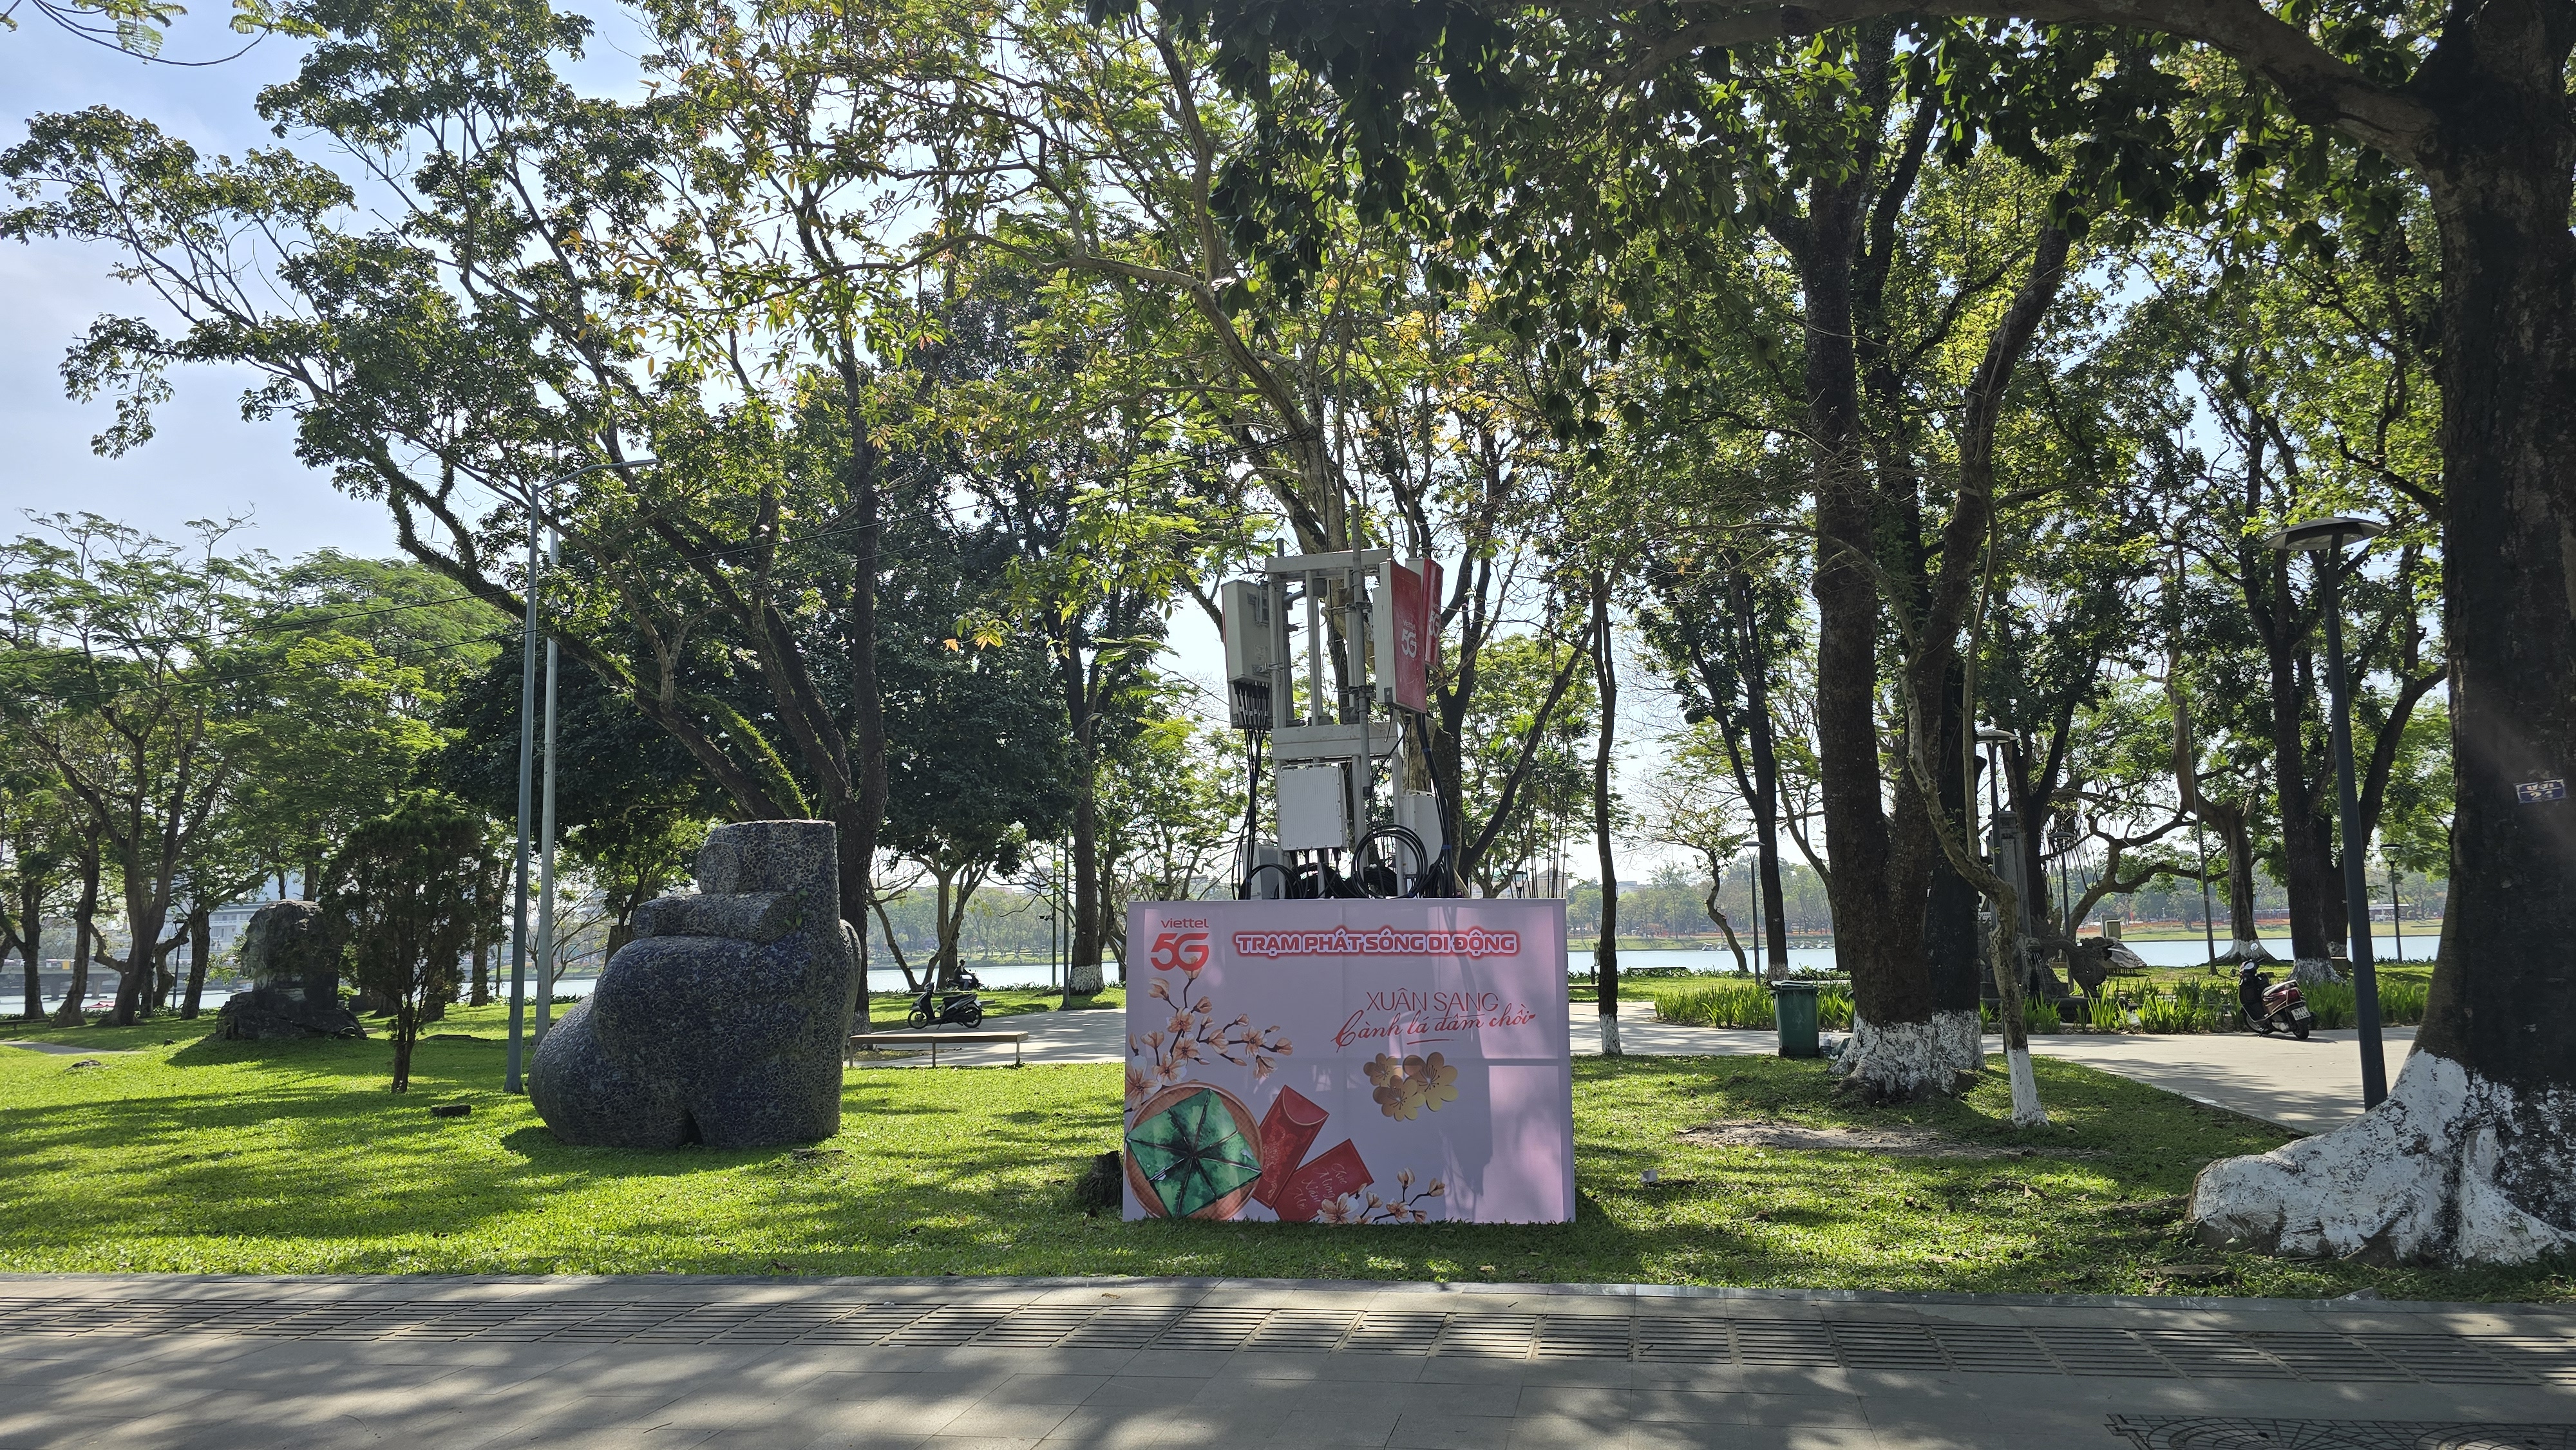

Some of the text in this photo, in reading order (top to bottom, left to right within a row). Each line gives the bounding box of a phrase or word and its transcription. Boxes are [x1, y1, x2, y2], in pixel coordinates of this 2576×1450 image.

[1401, 628, 1417, 658] 5G
[1160, 918, 1209, 928] viettel
[1150, 932, 1209, 972] 5G
[1236, 929, 1517, 956] TRẠM PHÁT SÓNG DI ĐỘNG
[1366, 987, 1499, 1013] XUÂN SANG
[1331, 1009, 1403, 1053] Cành
[1406, 1010, 1430, 1035] lá
[1489, 1003, 1536, 1028] chồi
